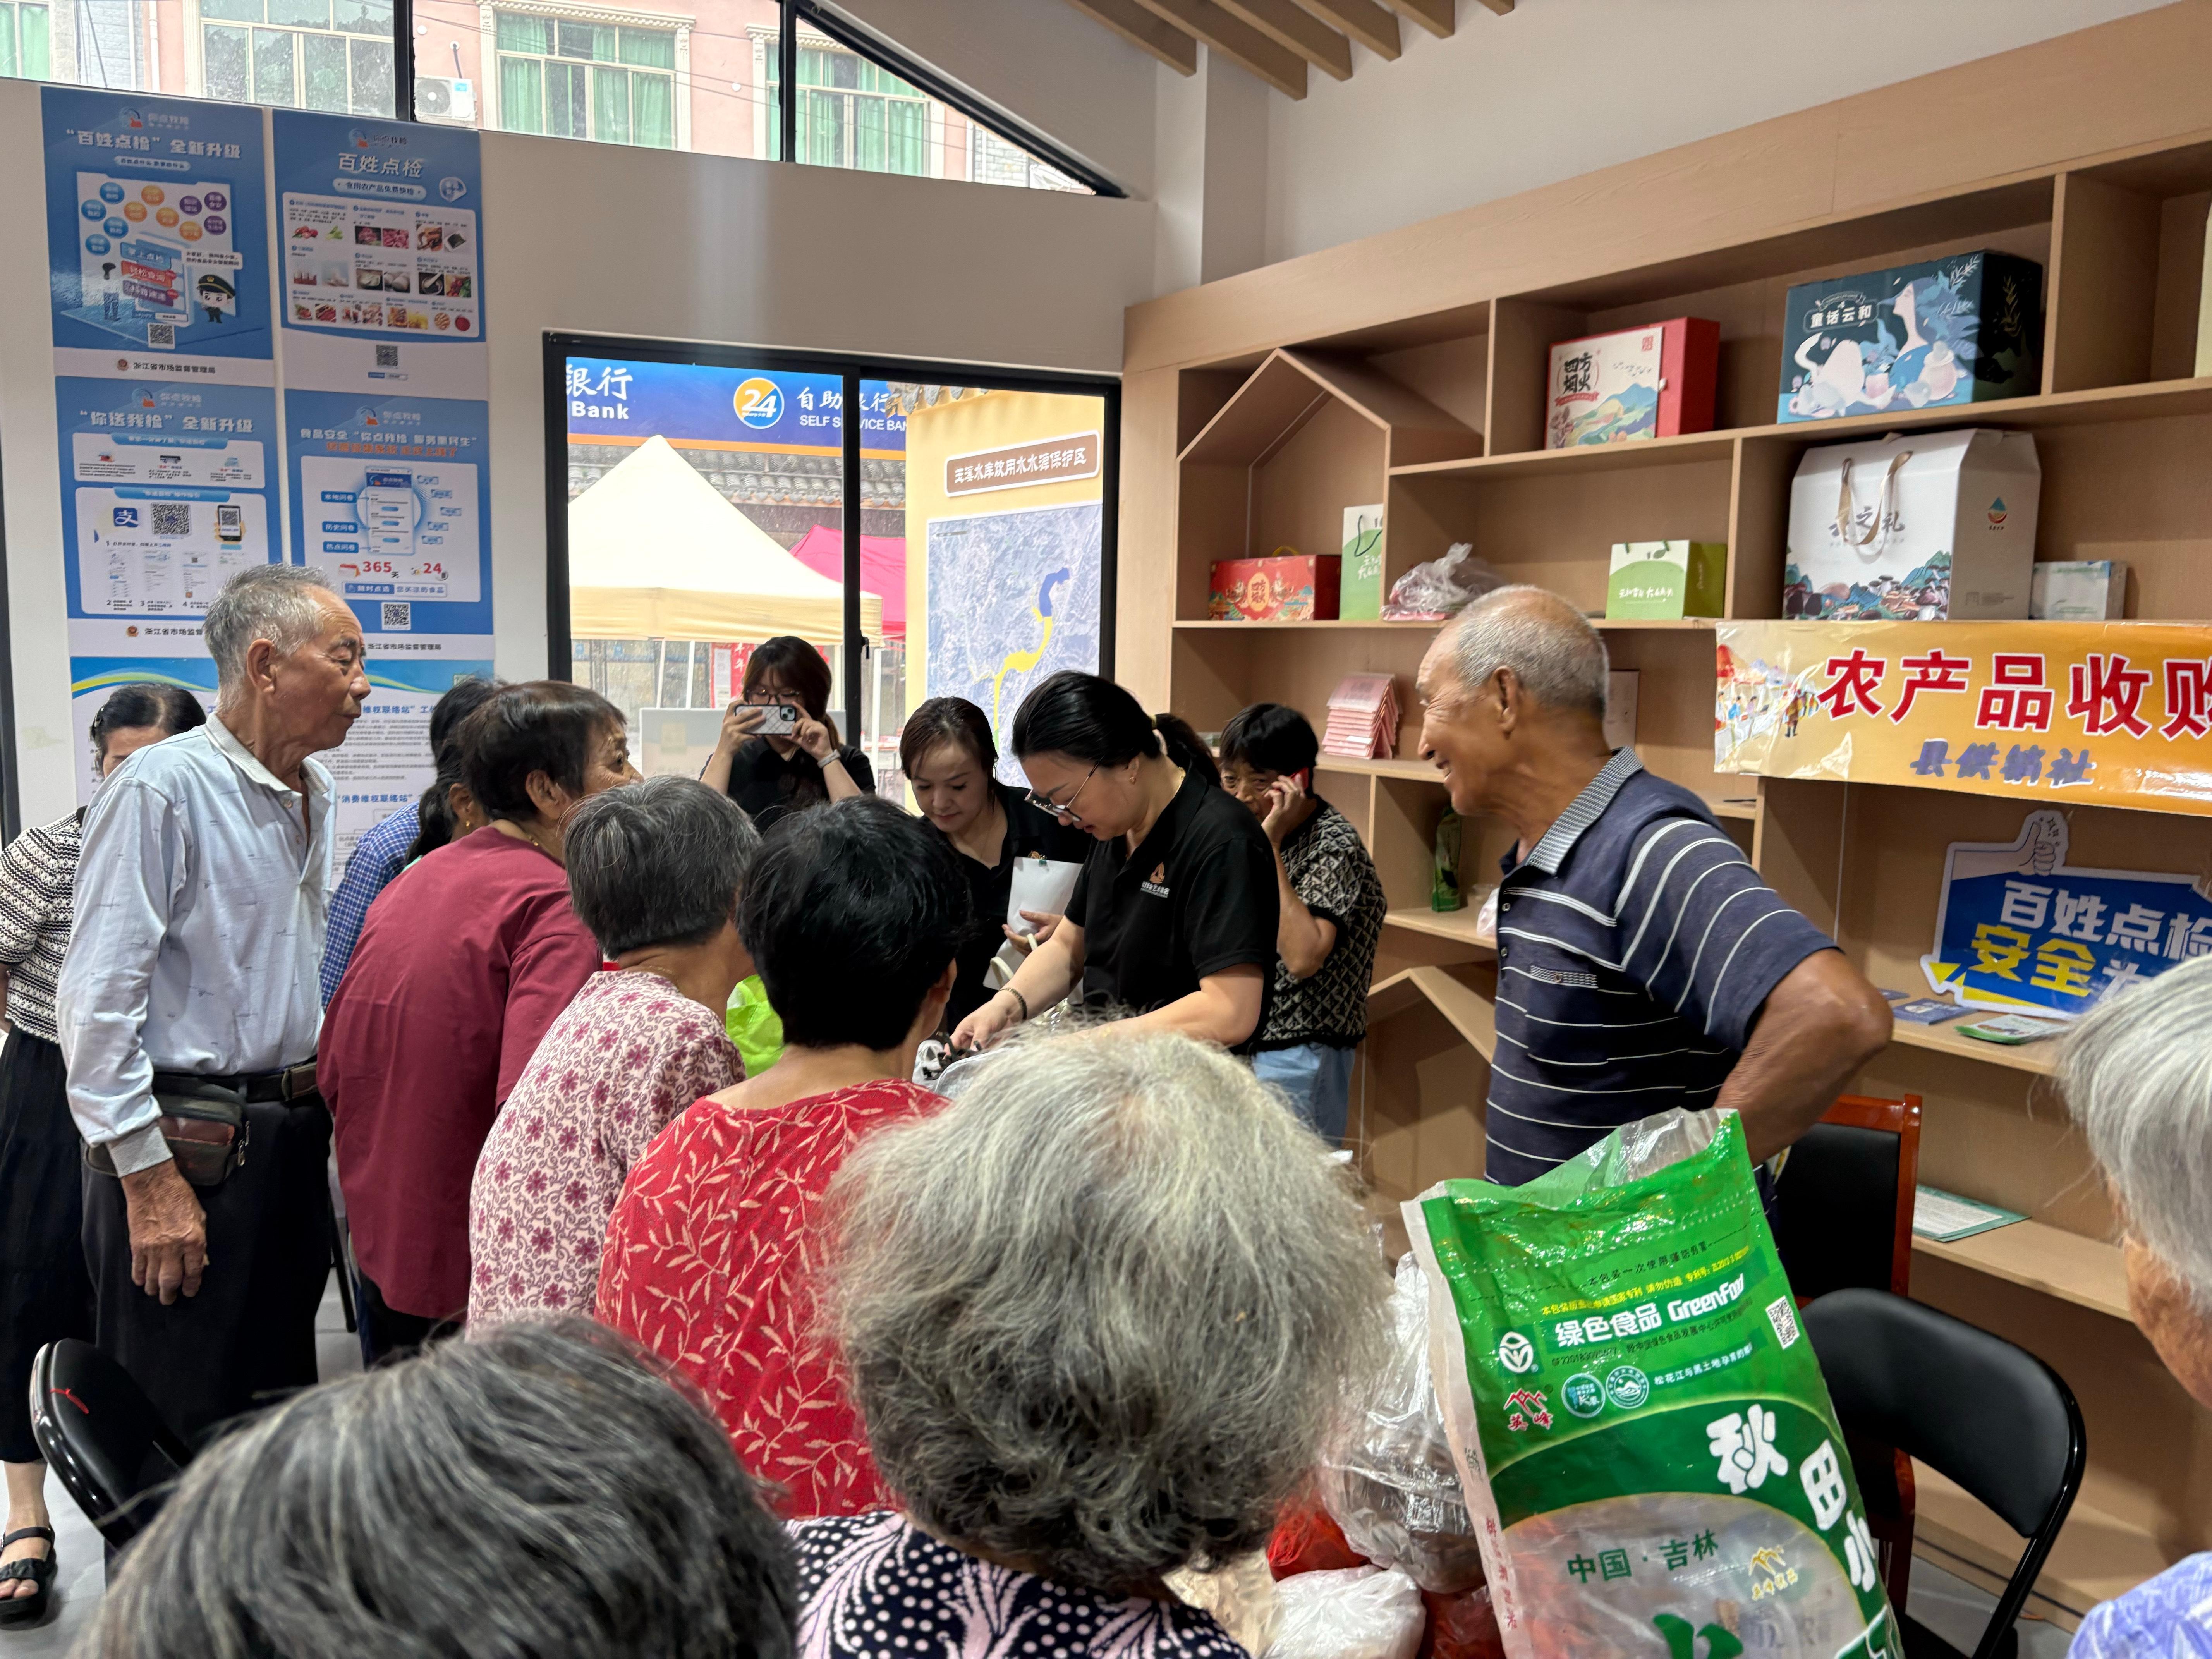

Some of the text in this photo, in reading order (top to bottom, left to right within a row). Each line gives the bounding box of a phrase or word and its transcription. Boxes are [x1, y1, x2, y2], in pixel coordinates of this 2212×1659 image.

[170, 139, 241, 159] 全新升级
[338, 153, 424, 178] 百姓点检
[1810, 304, 1872, 328] 童话云和
[133, 362, 216, 374] 浙江省市场监督管理局
[571, 400, 629, 420] Bank
[742, 389, 777, 418] 24
[183, 416, 253, 433] 全新升级
[799, 414, 831, 426] SELF
[422, 562, 442, 574] 24
[367, 643, 441, 651] 浙江省市场监督管理局
[1554, 1302, 1662, 1347] 绿色食品
[1566, 1528, 1719, 1583] 中国·吉林
